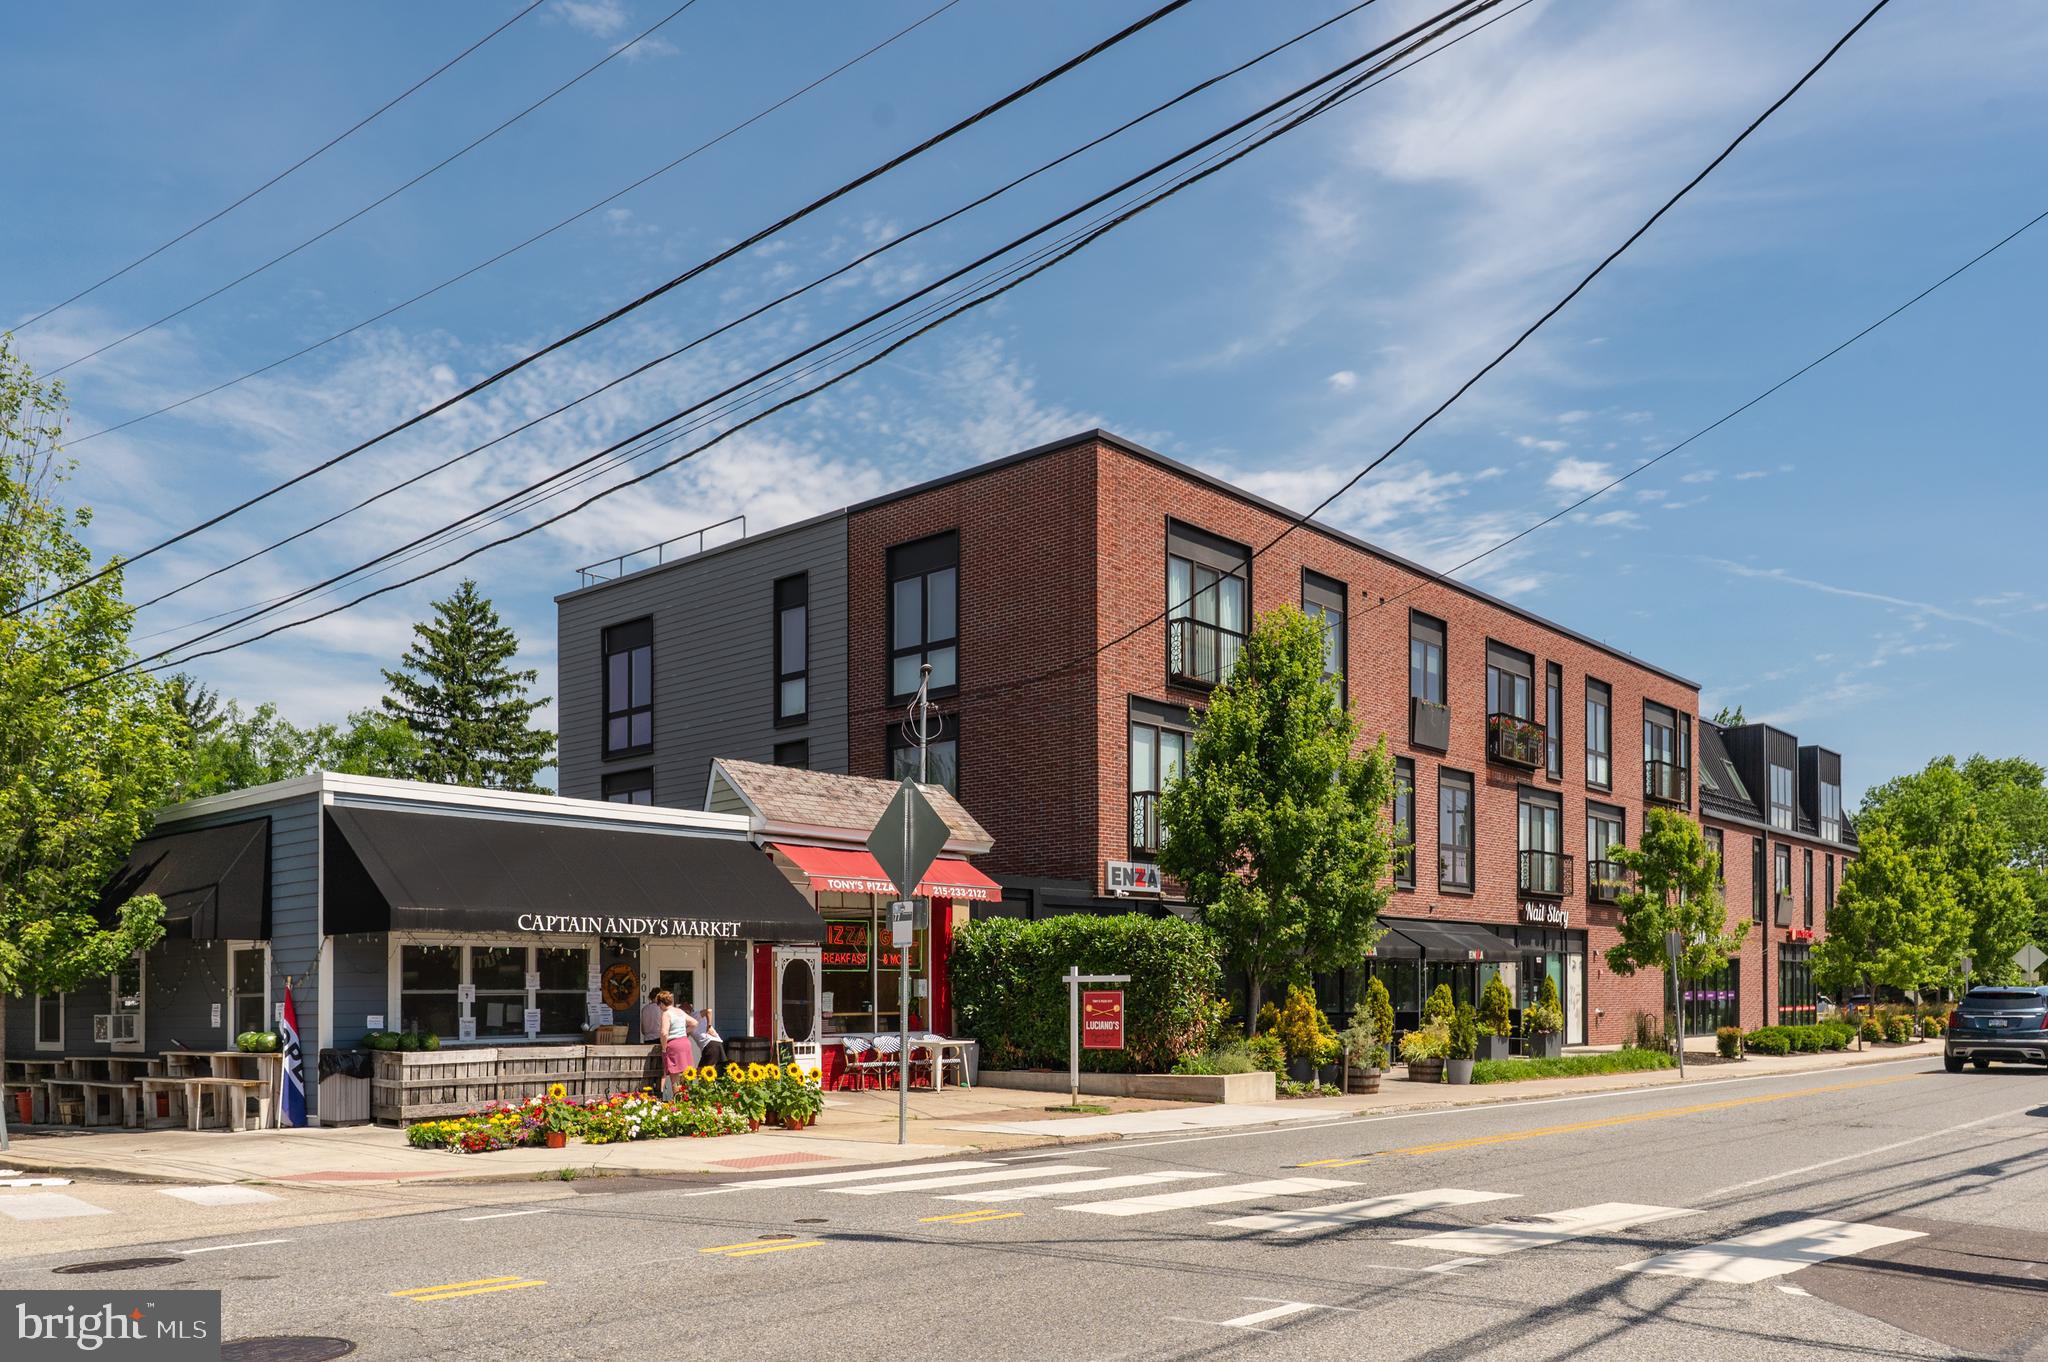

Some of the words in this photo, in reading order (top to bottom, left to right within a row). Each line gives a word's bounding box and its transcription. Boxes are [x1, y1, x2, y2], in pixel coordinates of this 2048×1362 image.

[828, 879, 863, 890] TONY'S
[867, 882, 895, 892] PIZZA
[1111, 867, 1158, 888] ENZA
[517, 913, 601, 933] CAPTAIN
[604, 917, 669, 935] ANDY'S
[672, 920, 741, 938] MARKET
[1525, 902, 1545, 921] Nail
[1547, 903, 1569, 929] Story
[827, 925, 868, 945] IZZA
[822, 952, 867, 965] REAKFAST
[891, 953, 912, 965] MOE
[1085, 1020, 1120, 1030] LUCIANO'S
